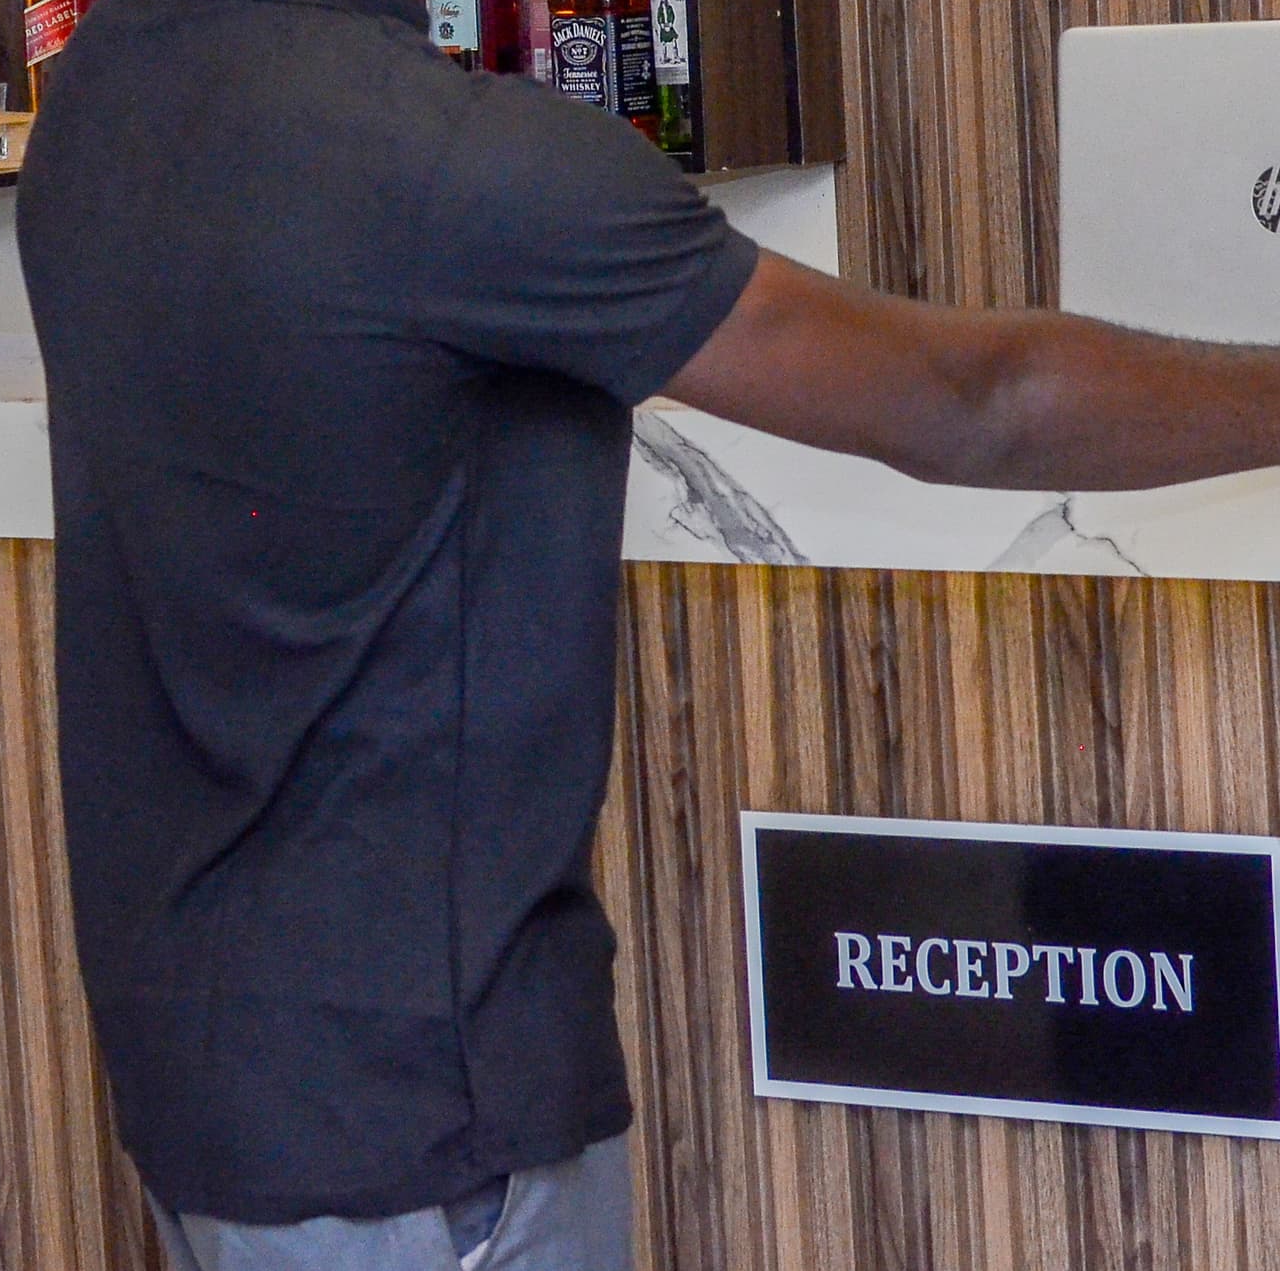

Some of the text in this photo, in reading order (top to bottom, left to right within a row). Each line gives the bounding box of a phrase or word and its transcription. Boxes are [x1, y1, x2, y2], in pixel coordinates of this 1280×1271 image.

[25, 7, 77, 38] RED LABEL
[552, 22, 607, 48] JACK DANIEL'S
[562, 67, 598, 79] Tennessee
[561, 82, 601, 92] WHISKEY
[834, 931, 1195, 1012] RECEPTION
